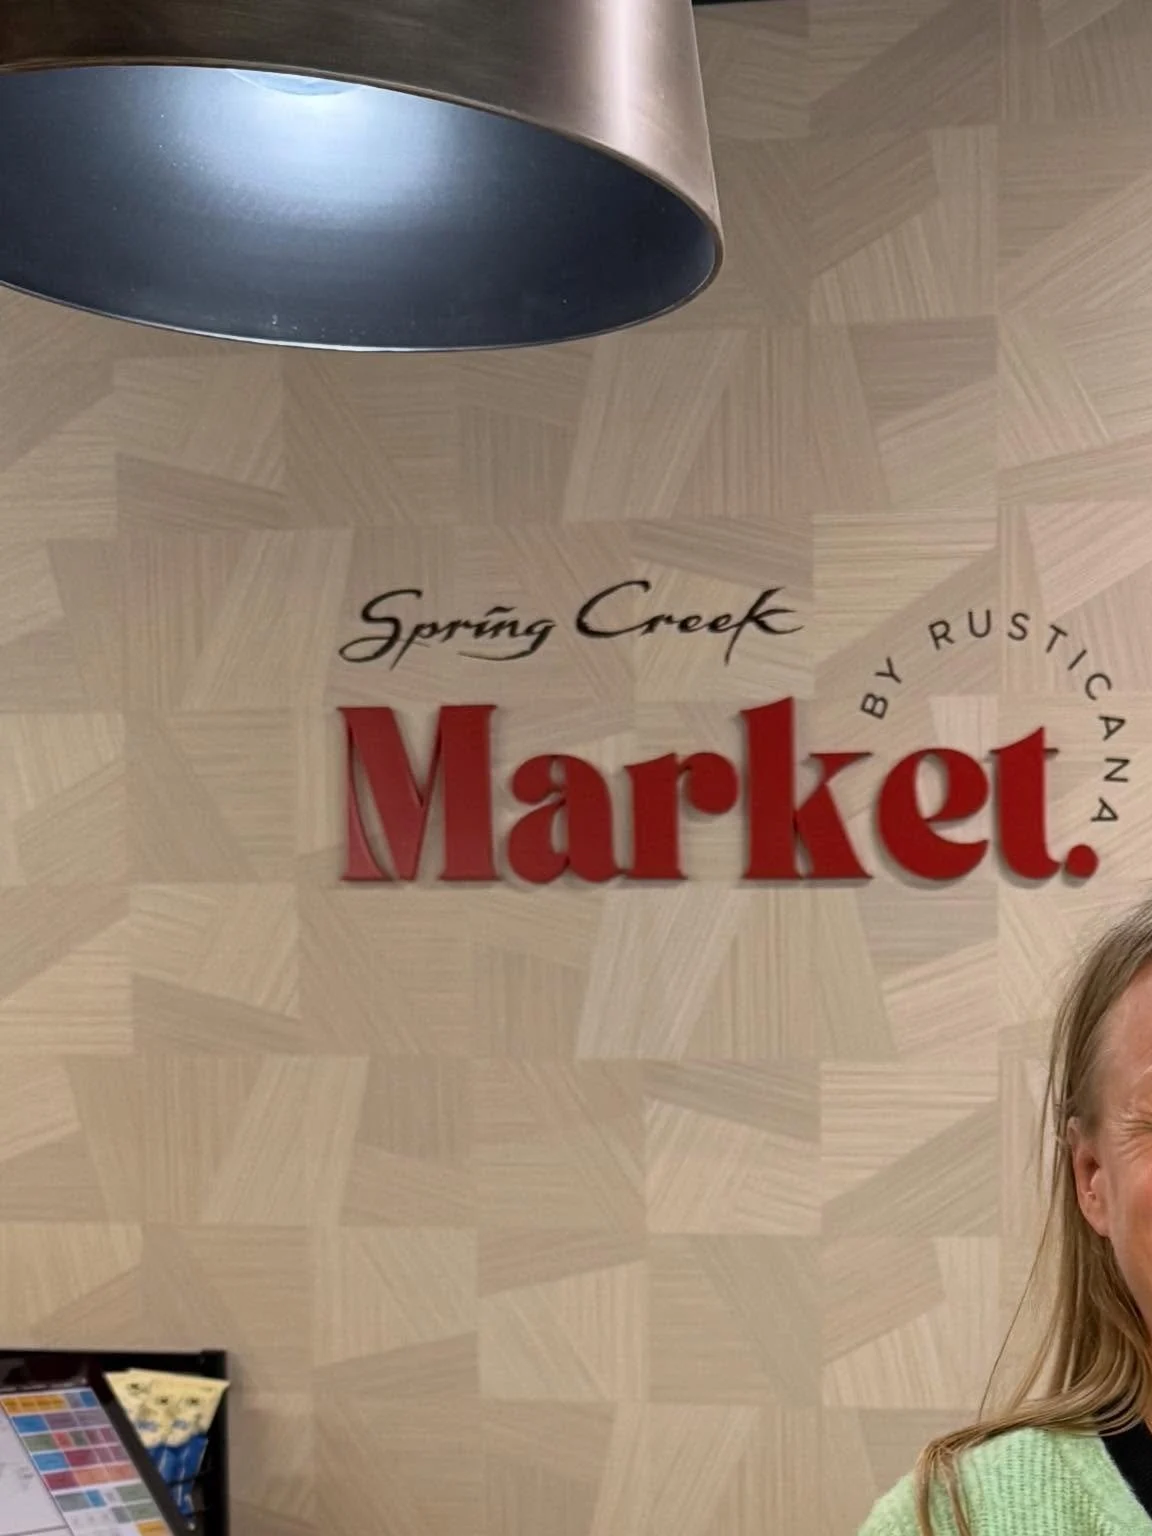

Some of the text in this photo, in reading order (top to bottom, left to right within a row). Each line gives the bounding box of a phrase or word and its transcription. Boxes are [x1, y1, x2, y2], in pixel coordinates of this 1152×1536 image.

[338, 580, 805, 671] Spring Creek
[859, 608, 1131, 823] BY RUSTICANA
[336, 696, 1099, 884] Market.
